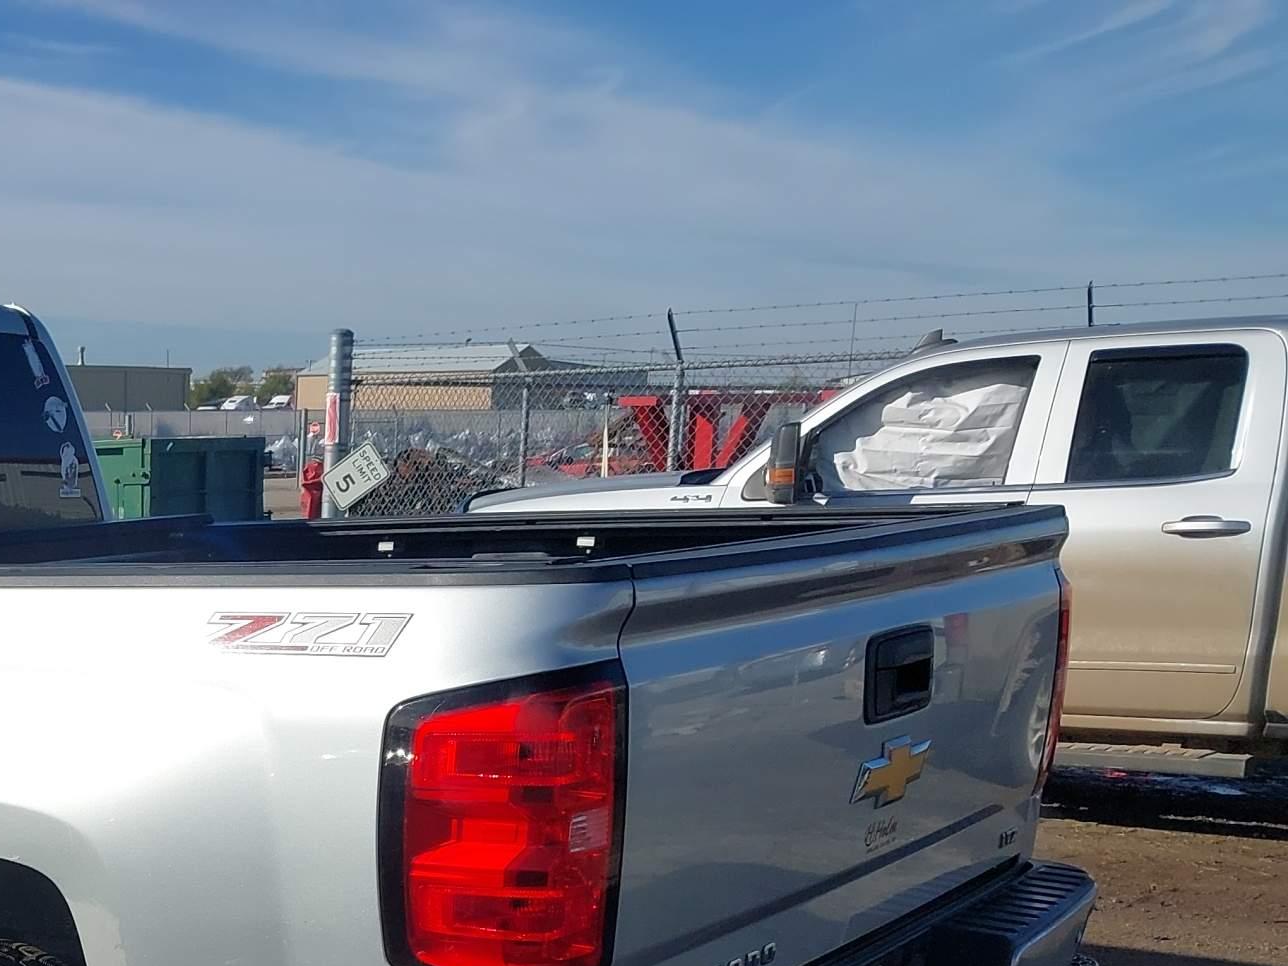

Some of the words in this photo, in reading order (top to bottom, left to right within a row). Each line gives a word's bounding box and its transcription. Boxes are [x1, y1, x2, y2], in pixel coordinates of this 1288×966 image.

[352, 458, 372, 483] LIMIT
[359, 450, 382, 481] SPEED
[335, 473, 356, 493] 5
[207, 611, 415, 653] Z71
[310, 645, 337, 654] OFF
[342, 645, 386, 655] ROAD
